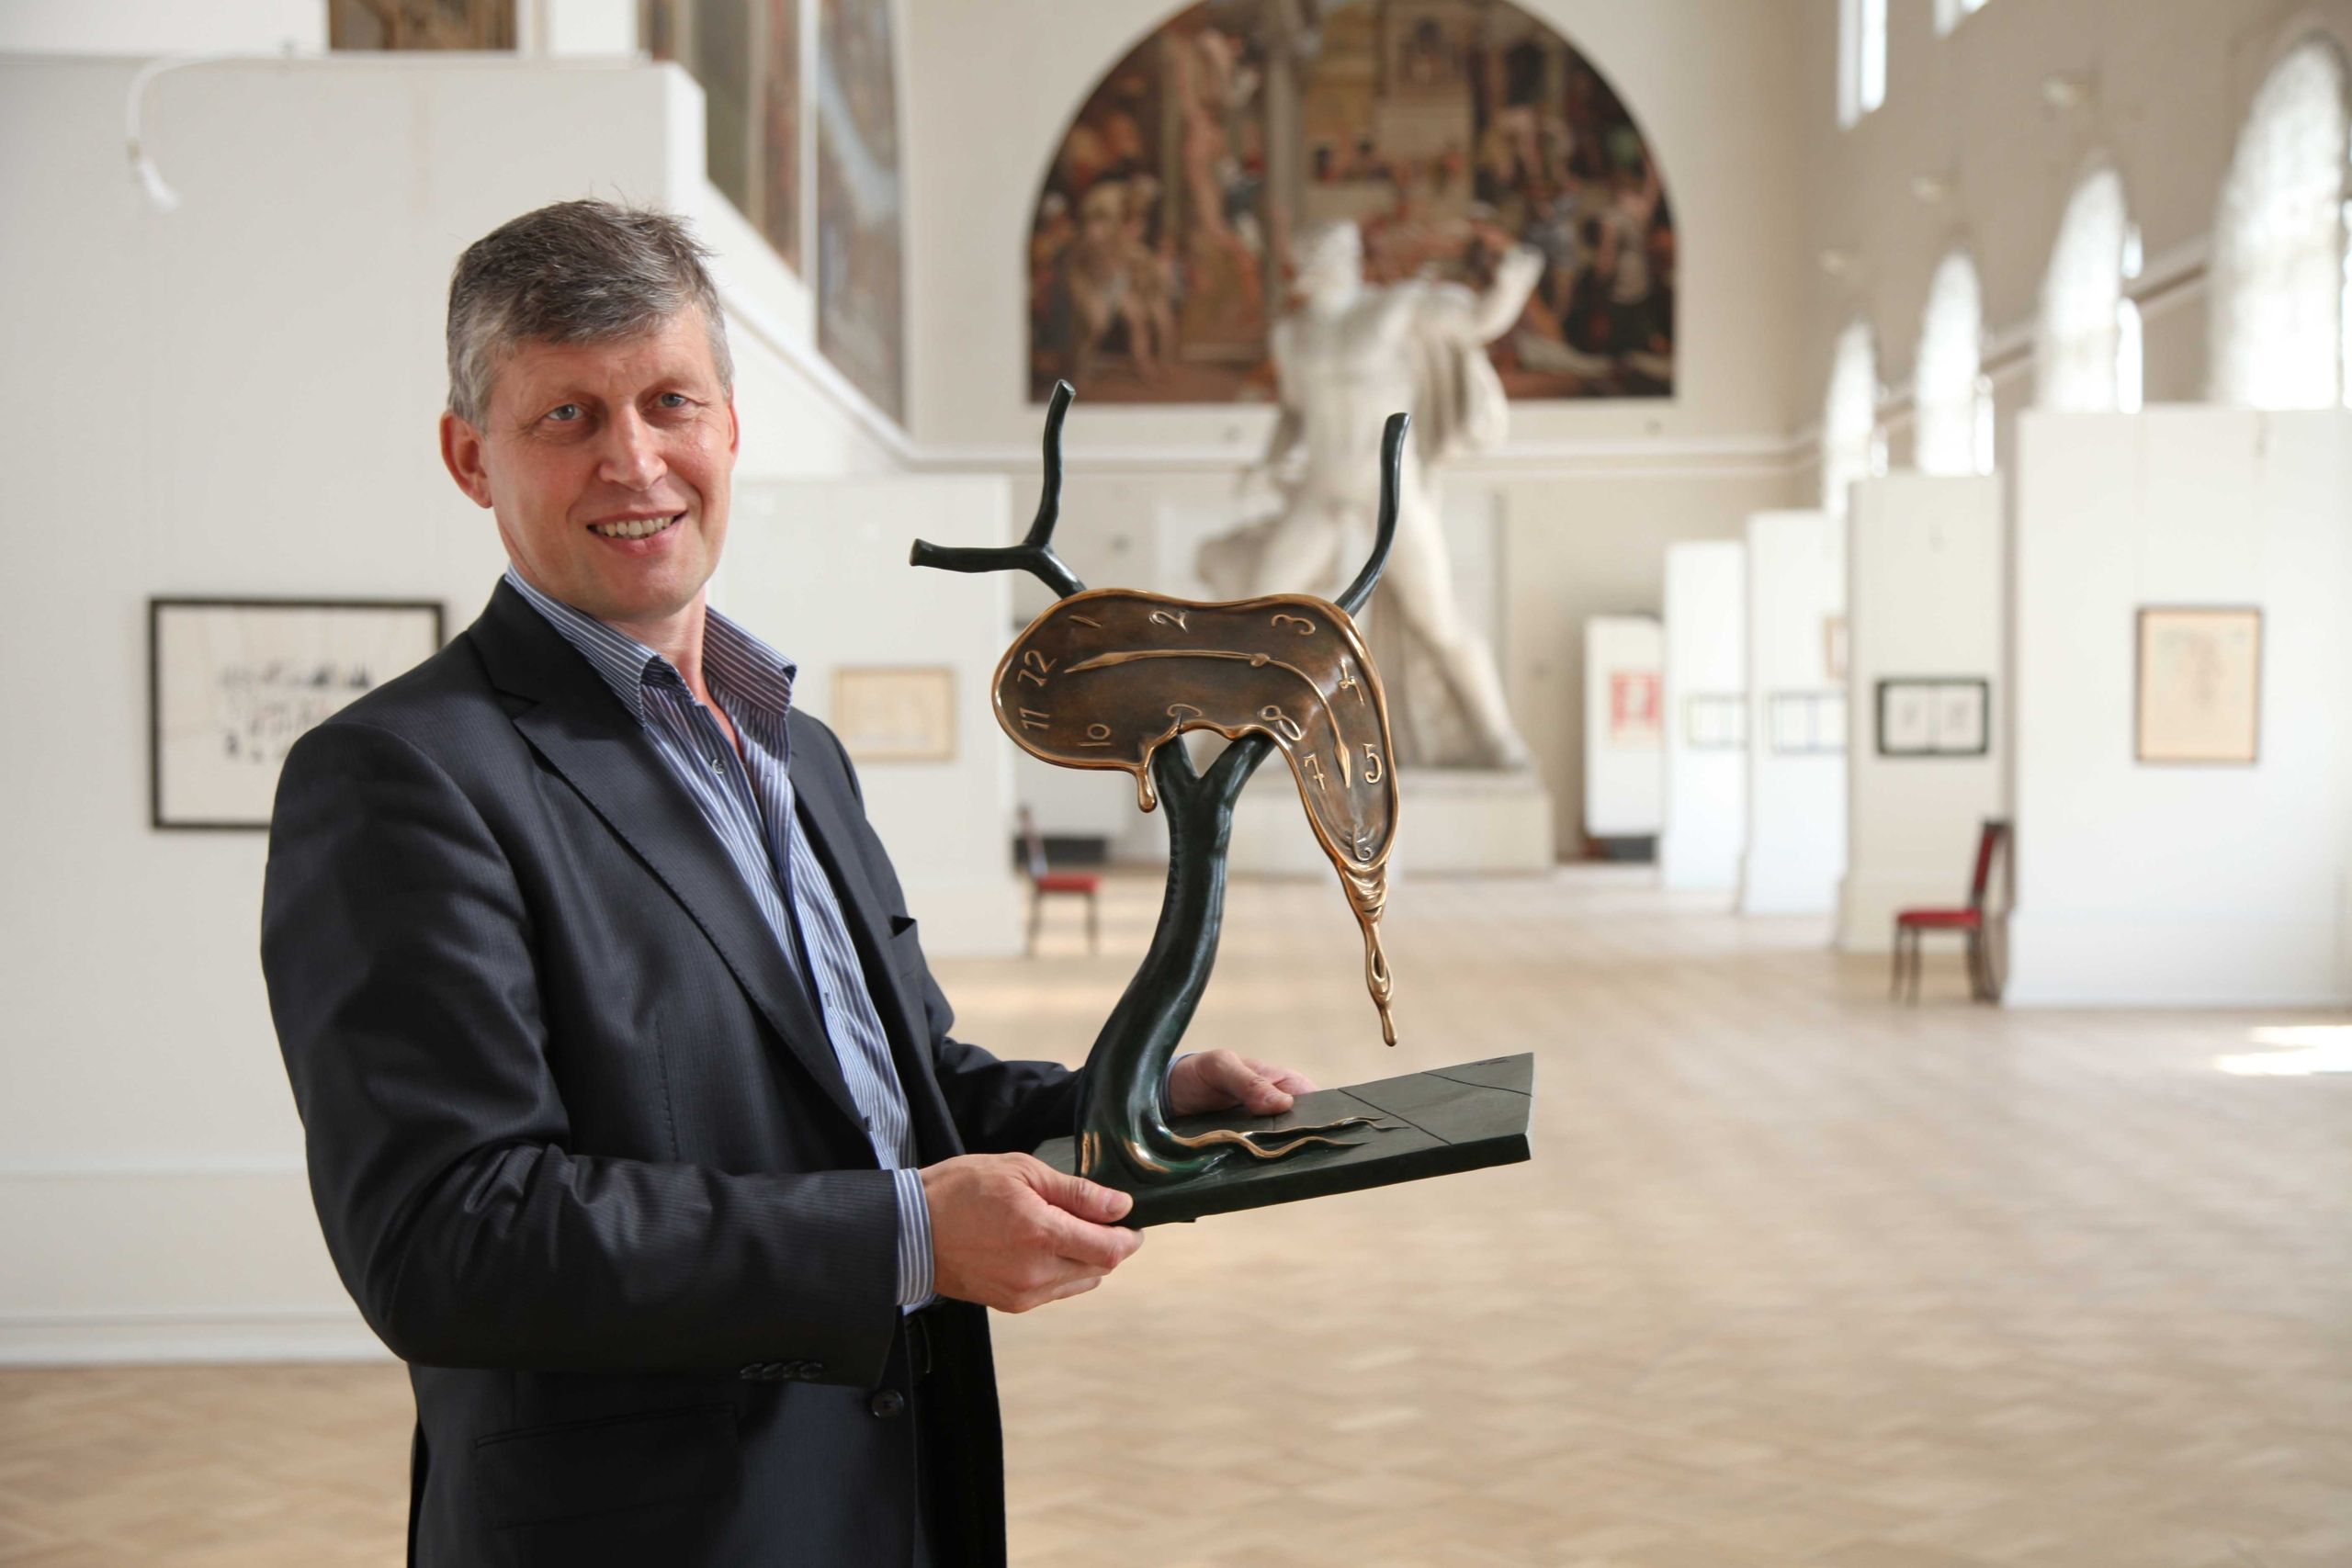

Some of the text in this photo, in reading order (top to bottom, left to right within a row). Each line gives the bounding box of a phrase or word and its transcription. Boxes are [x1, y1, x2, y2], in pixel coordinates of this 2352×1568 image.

[1068, 615, 1103, 629] 1
[1148, 610, 1189, 633] 2
[1271, 614, 1316, 636] 3
[1017, 649, 1057, 687] 12
[1338, 659, 1365, 706] 4
[1019, 707, 1051, 729] 11
[1260, 705, 1302, 741] 8
[1078, 723, 1112, 747] 10
[1303, 753, 1326, 791] 7
[1363, 743, 1383, 784] 5
